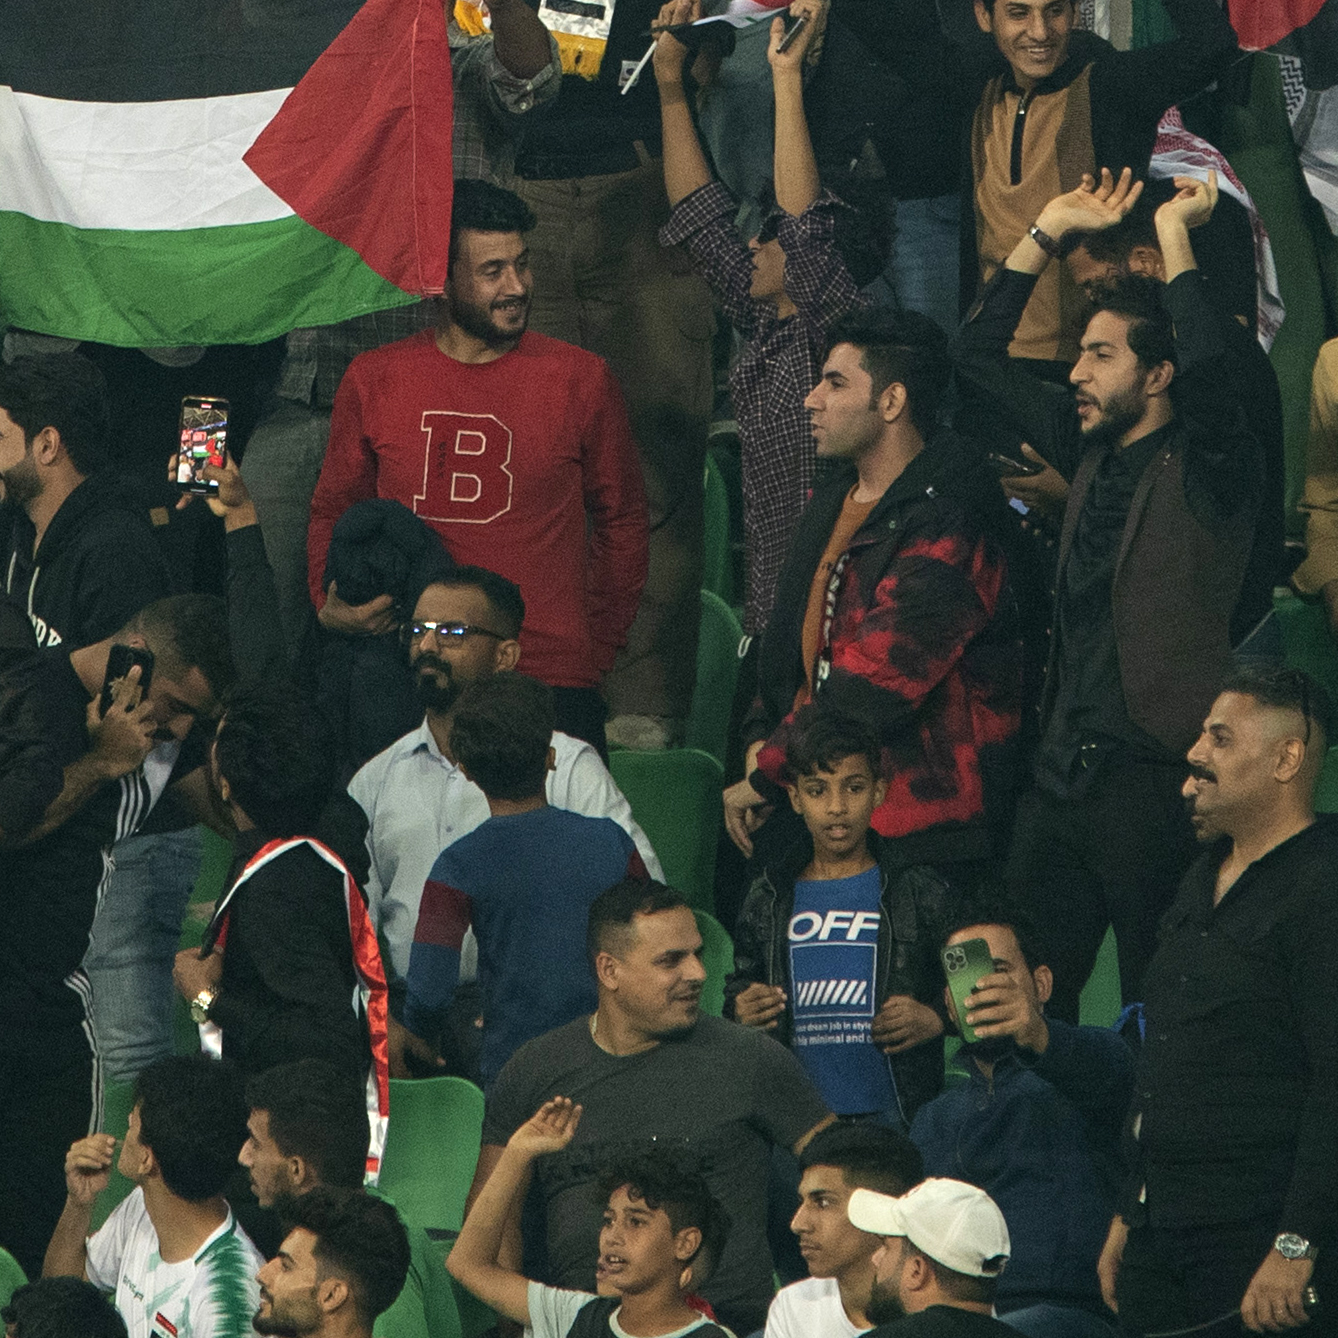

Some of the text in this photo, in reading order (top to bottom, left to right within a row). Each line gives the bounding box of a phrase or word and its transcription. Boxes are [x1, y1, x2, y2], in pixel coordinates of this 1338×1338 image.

[413, 410, 513, 524] B
[787, 909, 882, 942] OFF
[846, 1033, 865, 1044] and
